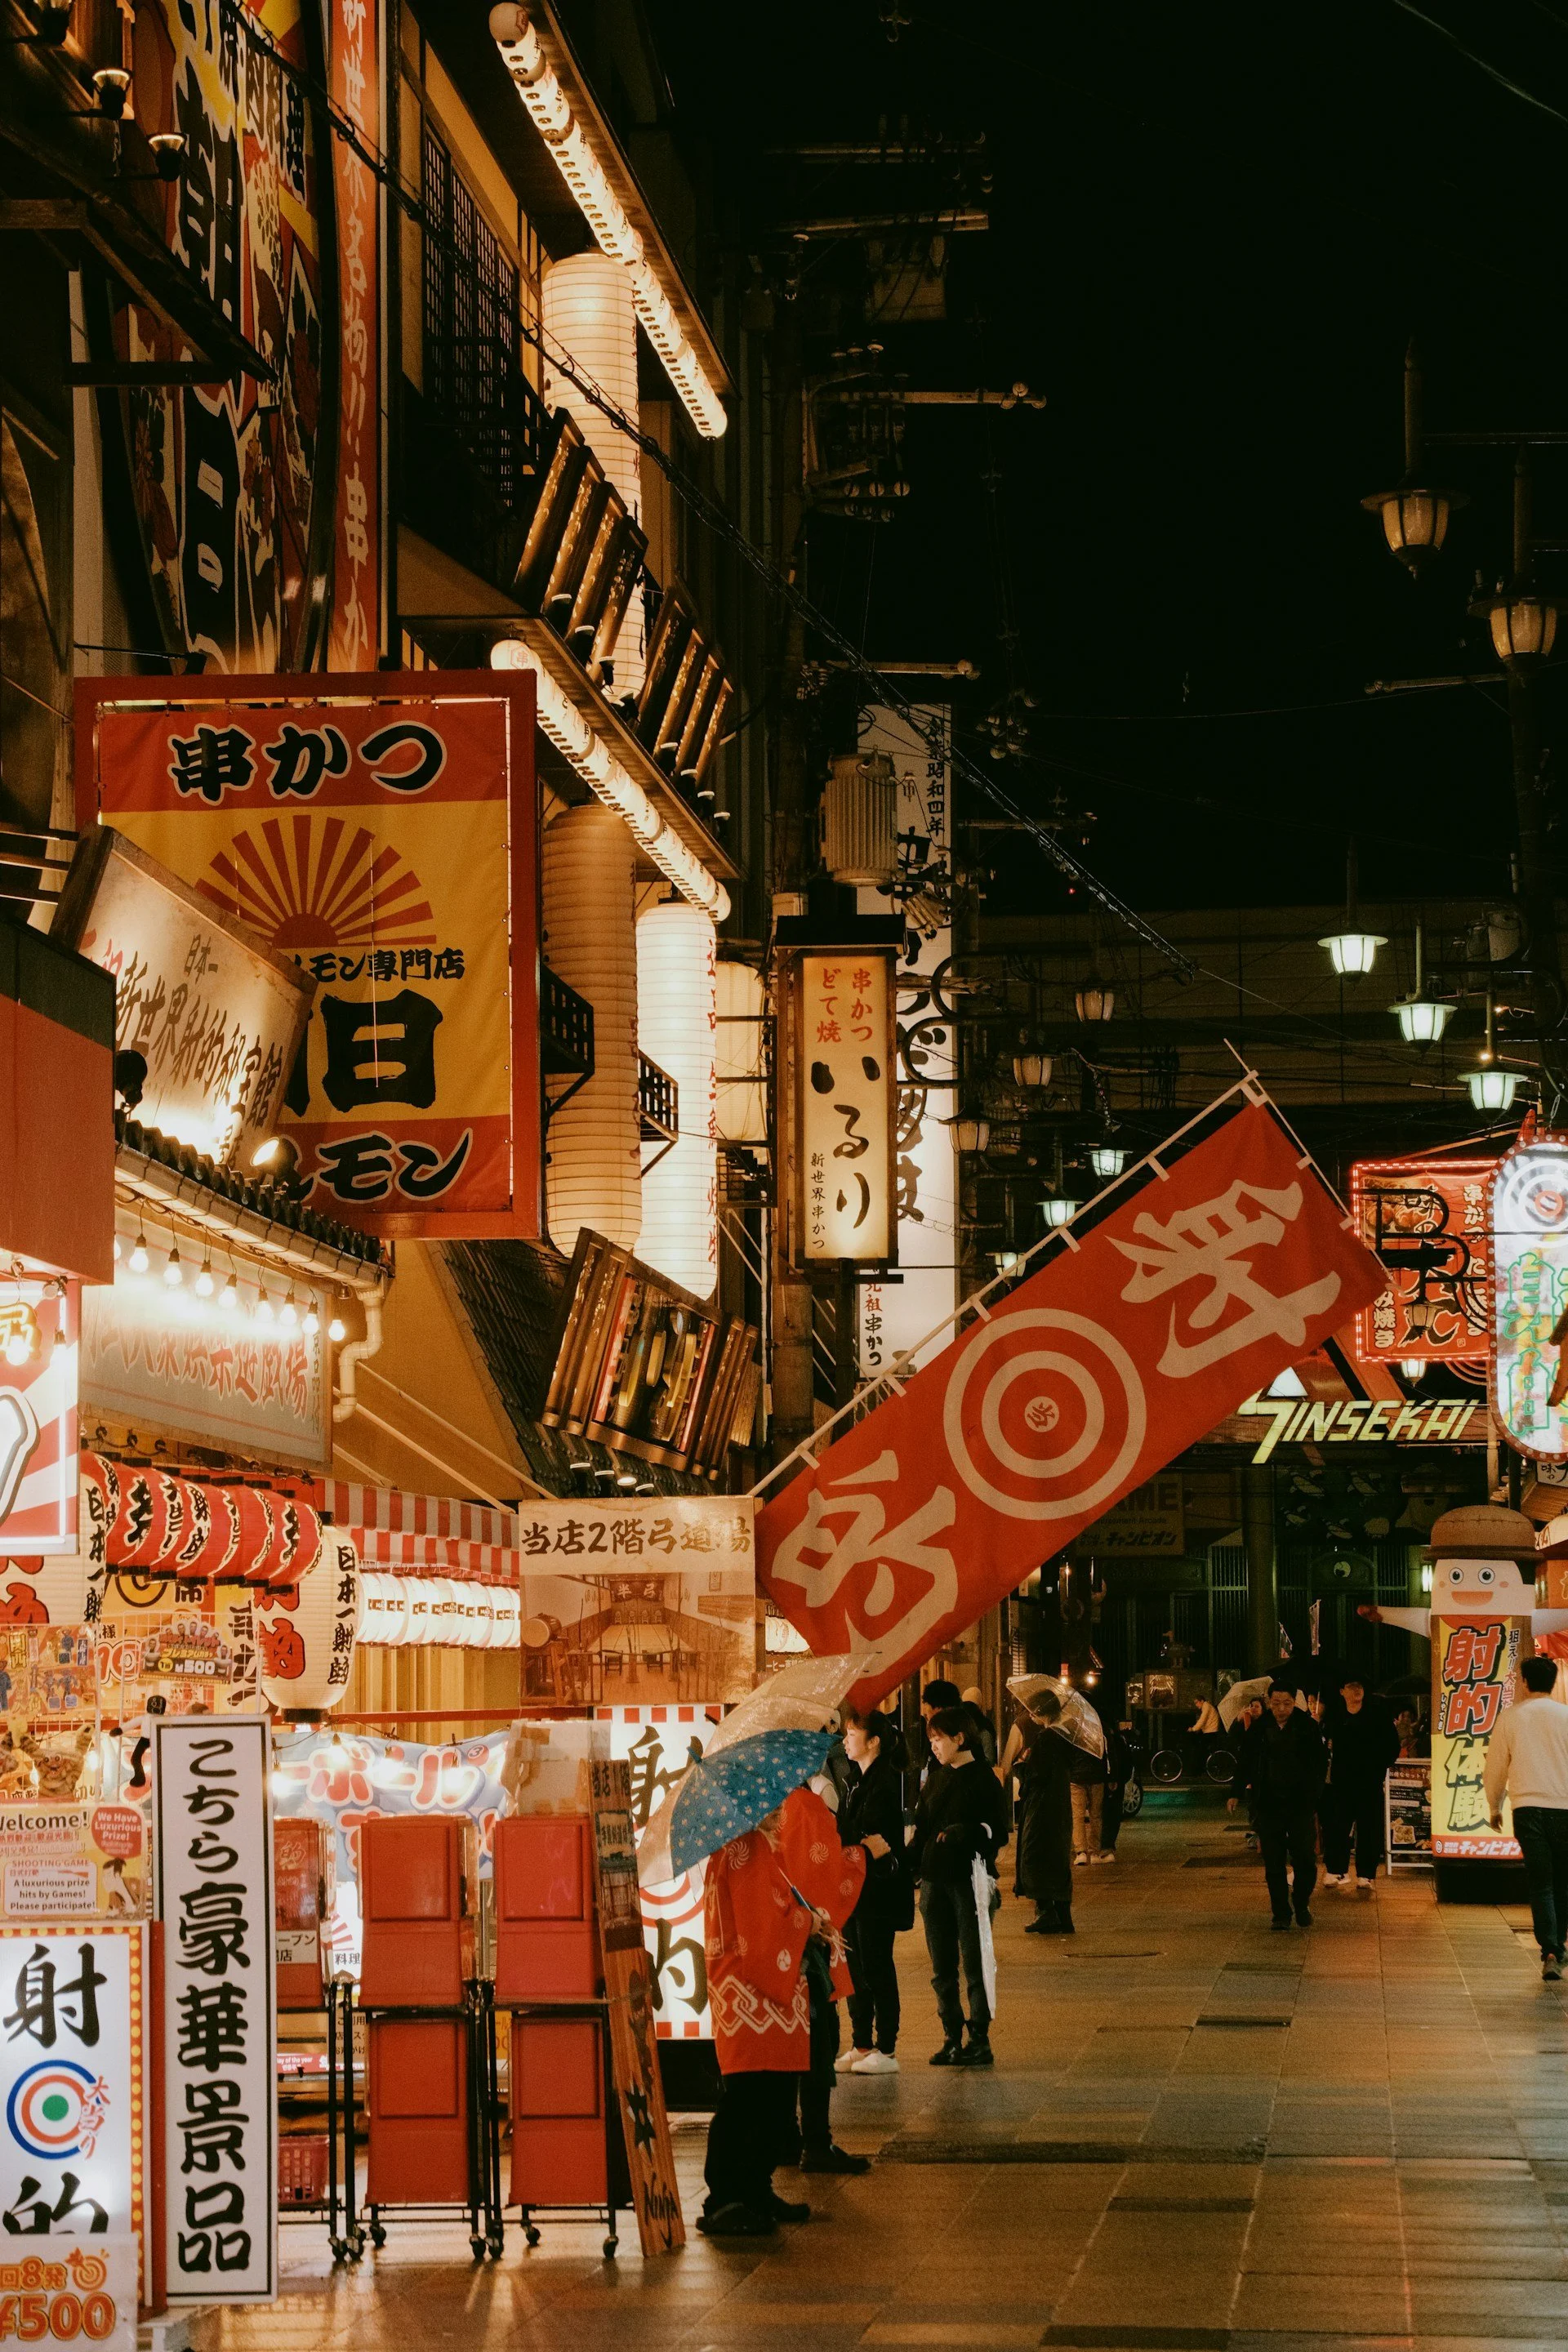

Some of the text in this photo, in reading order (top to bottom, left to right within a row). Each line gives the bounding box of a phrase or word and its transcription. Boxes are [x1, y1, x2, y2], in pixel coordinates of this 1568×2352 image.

[167, 719, 447, 806] 串かつ
[184, 933, 219, 984] 日本一
[292, 947, 466, 982] モン専門店
[817, 967, 842, 1044] どて焼
[851, 968, 874, 1042] 串かつ
[810, 1152, 826, 1250] 新世界串かつ
[521, 1516, 751, 1557] 当店2階弓道場
[95, 1821, 141, 1832] Luxurious
[97, 1812, 138, 1823] We Have
[102, 1830, 130, 1841] Prize!
[12, 1859, 90, 1869] SHOOTING GAME
[20, 1890, 86, 1900] hits by Games!
[67, 1880, 90, 1889] prize
[11, 1901, 96, 1912] Please participate!
[276, 1934, 316, 1947] ープン
[335, 1952, 361, 1965] 料理
[2, 1942, 109, 2050] 射
[174, 1737, 252, 2274] こちら豪華景品
[0, 2292, 115, 2342] ¥500
